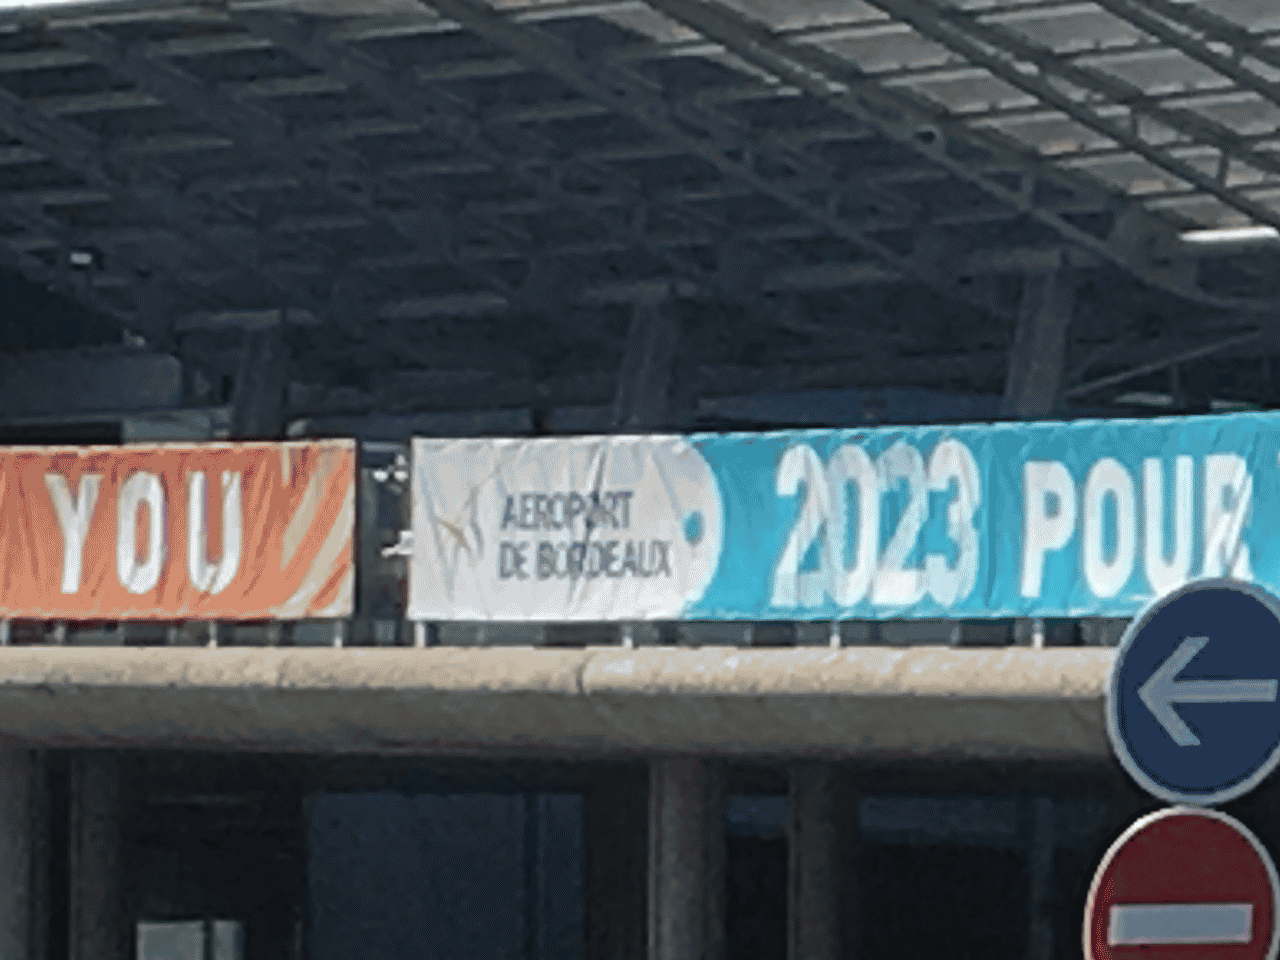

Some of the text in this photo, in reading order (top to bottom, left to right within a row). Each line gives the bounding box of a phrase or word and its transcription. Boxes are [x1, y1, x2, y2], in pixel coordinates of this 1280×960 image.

[44, 470, 243, 595] YOU
[499, 539, 672, 580] DE BORDEAUX
[772, 437, 981, 608] 2023
[1020, 452, 1255, 600] POUR
